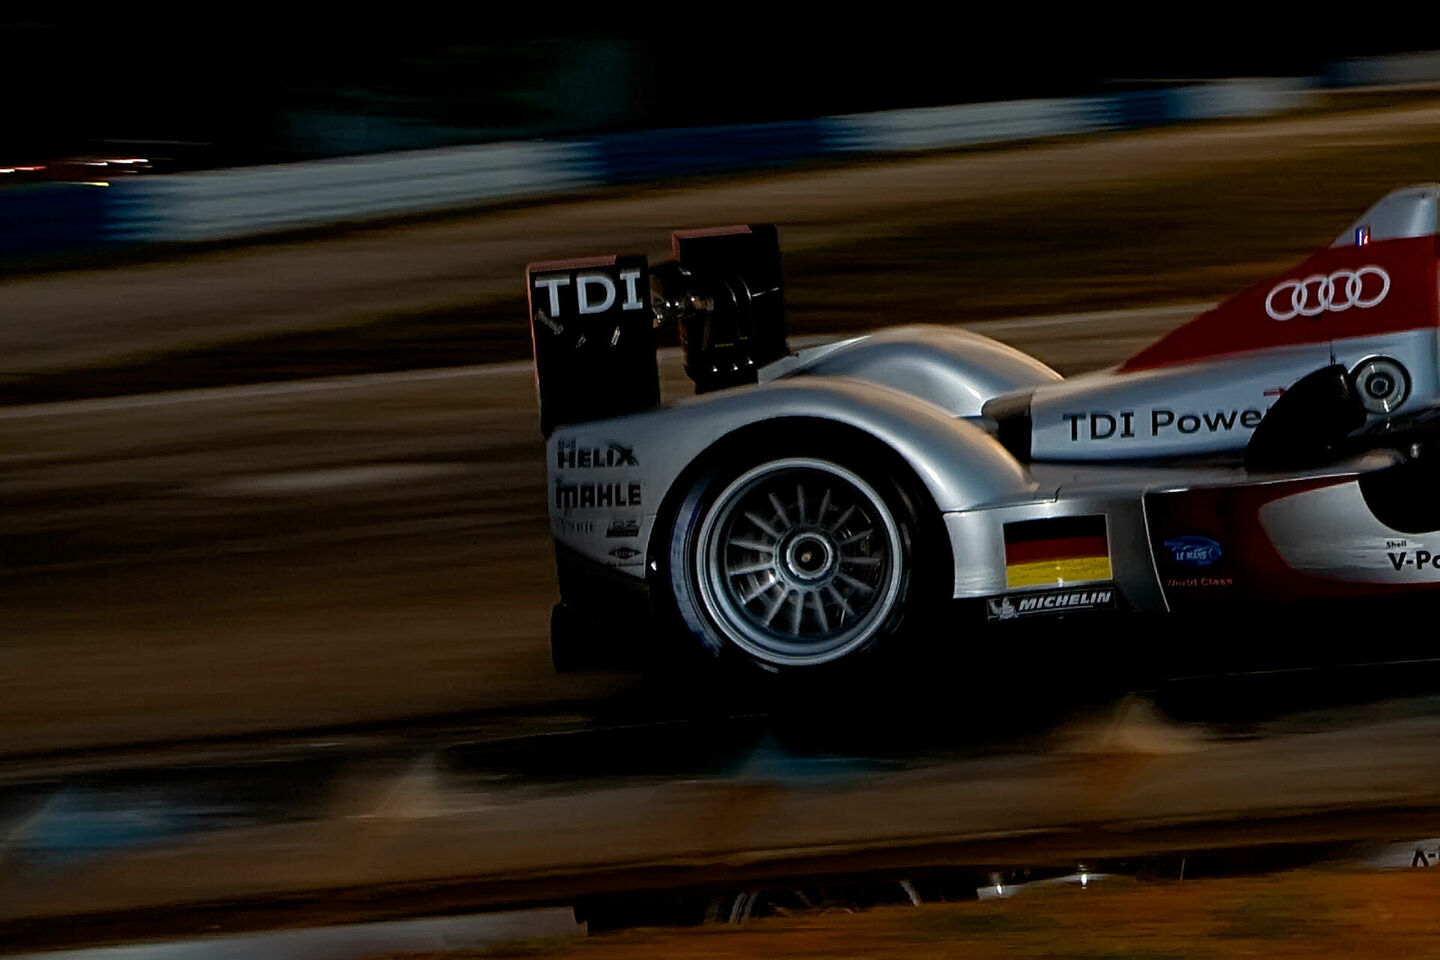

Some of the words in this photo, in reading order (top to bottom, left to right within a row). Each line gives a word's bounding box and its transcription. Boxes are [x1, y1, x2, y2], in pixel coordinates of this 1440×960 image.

[534, 270, 643, 317] TDI
[1062, 410, 1135, 441] TDI
[1151, 407, 1272, 436] Powe
[556, 483, 641, 509] MAHLE
[1386, 541, 1407, 549] Shell
[1019, 591, 1111, 611] MICHELIN
